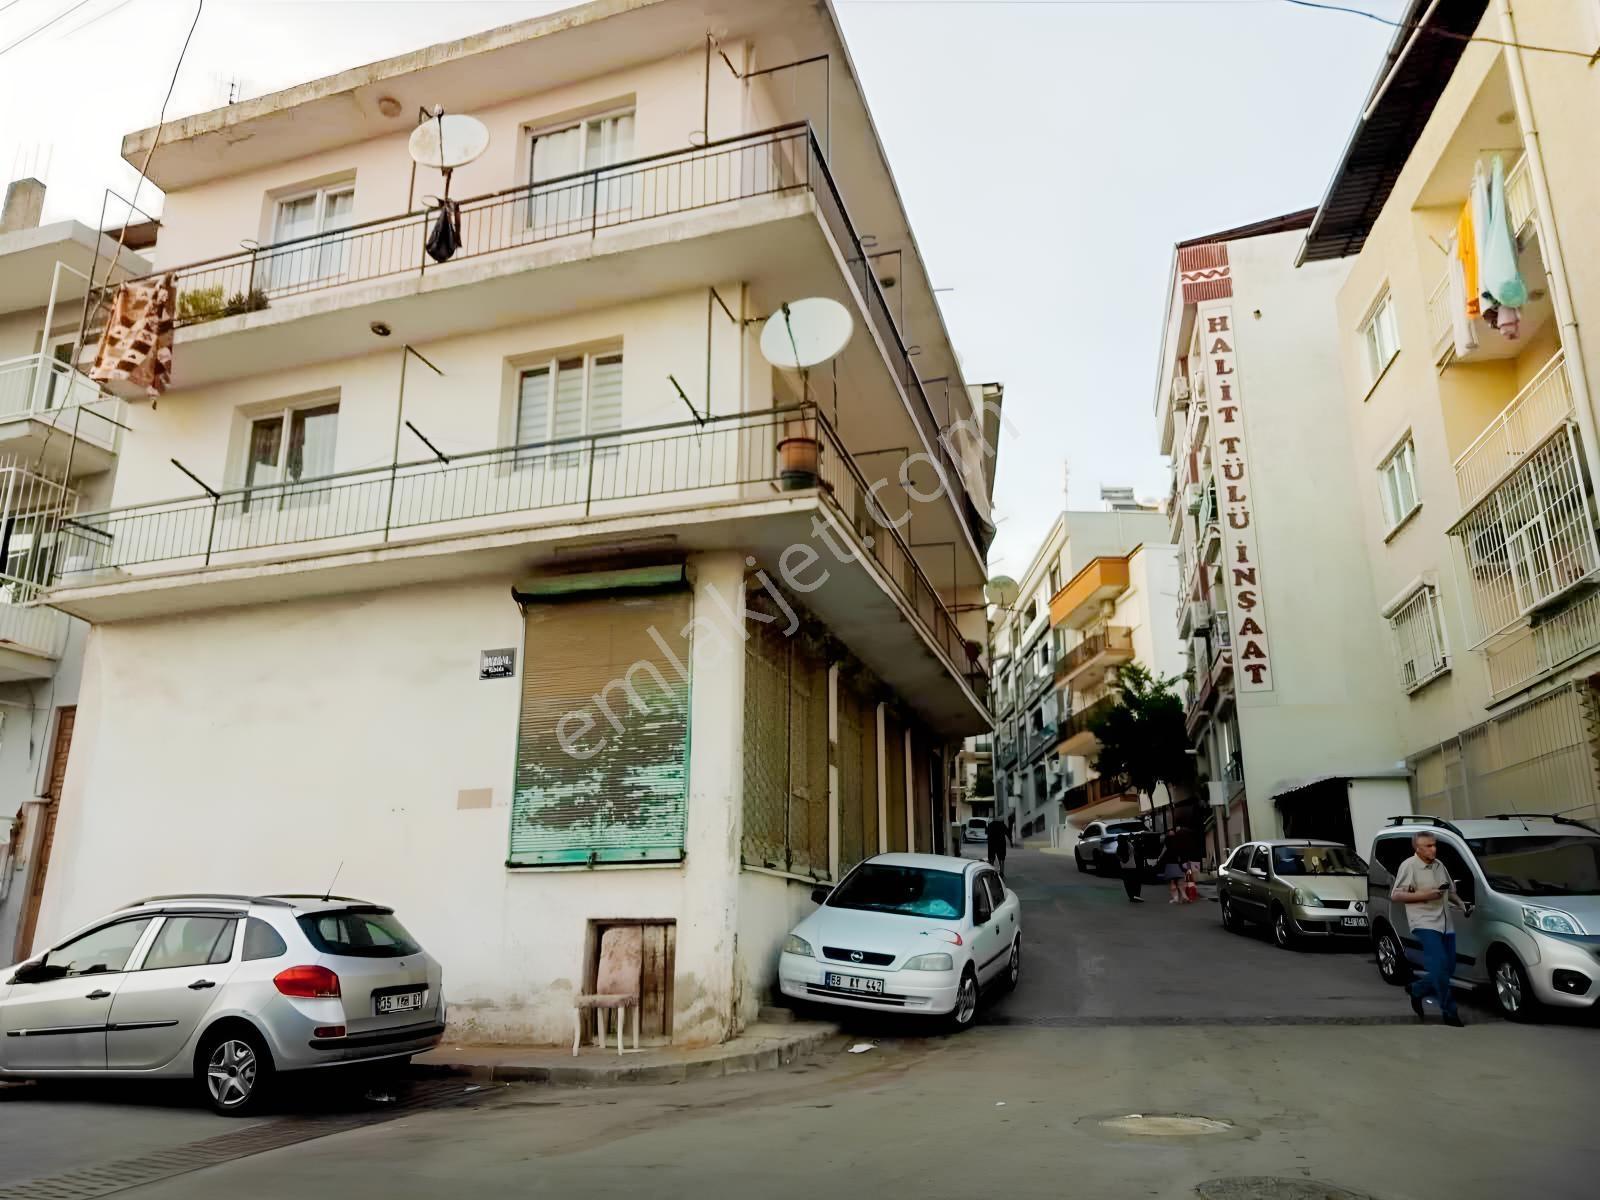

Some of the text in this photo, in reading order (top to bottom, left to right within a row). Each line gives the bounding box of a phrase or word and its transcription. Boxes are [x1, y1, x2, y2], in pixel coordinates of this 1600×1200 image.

[1206, 315, 1267, 684] HALİT TÜLÜ İNŞAAT
